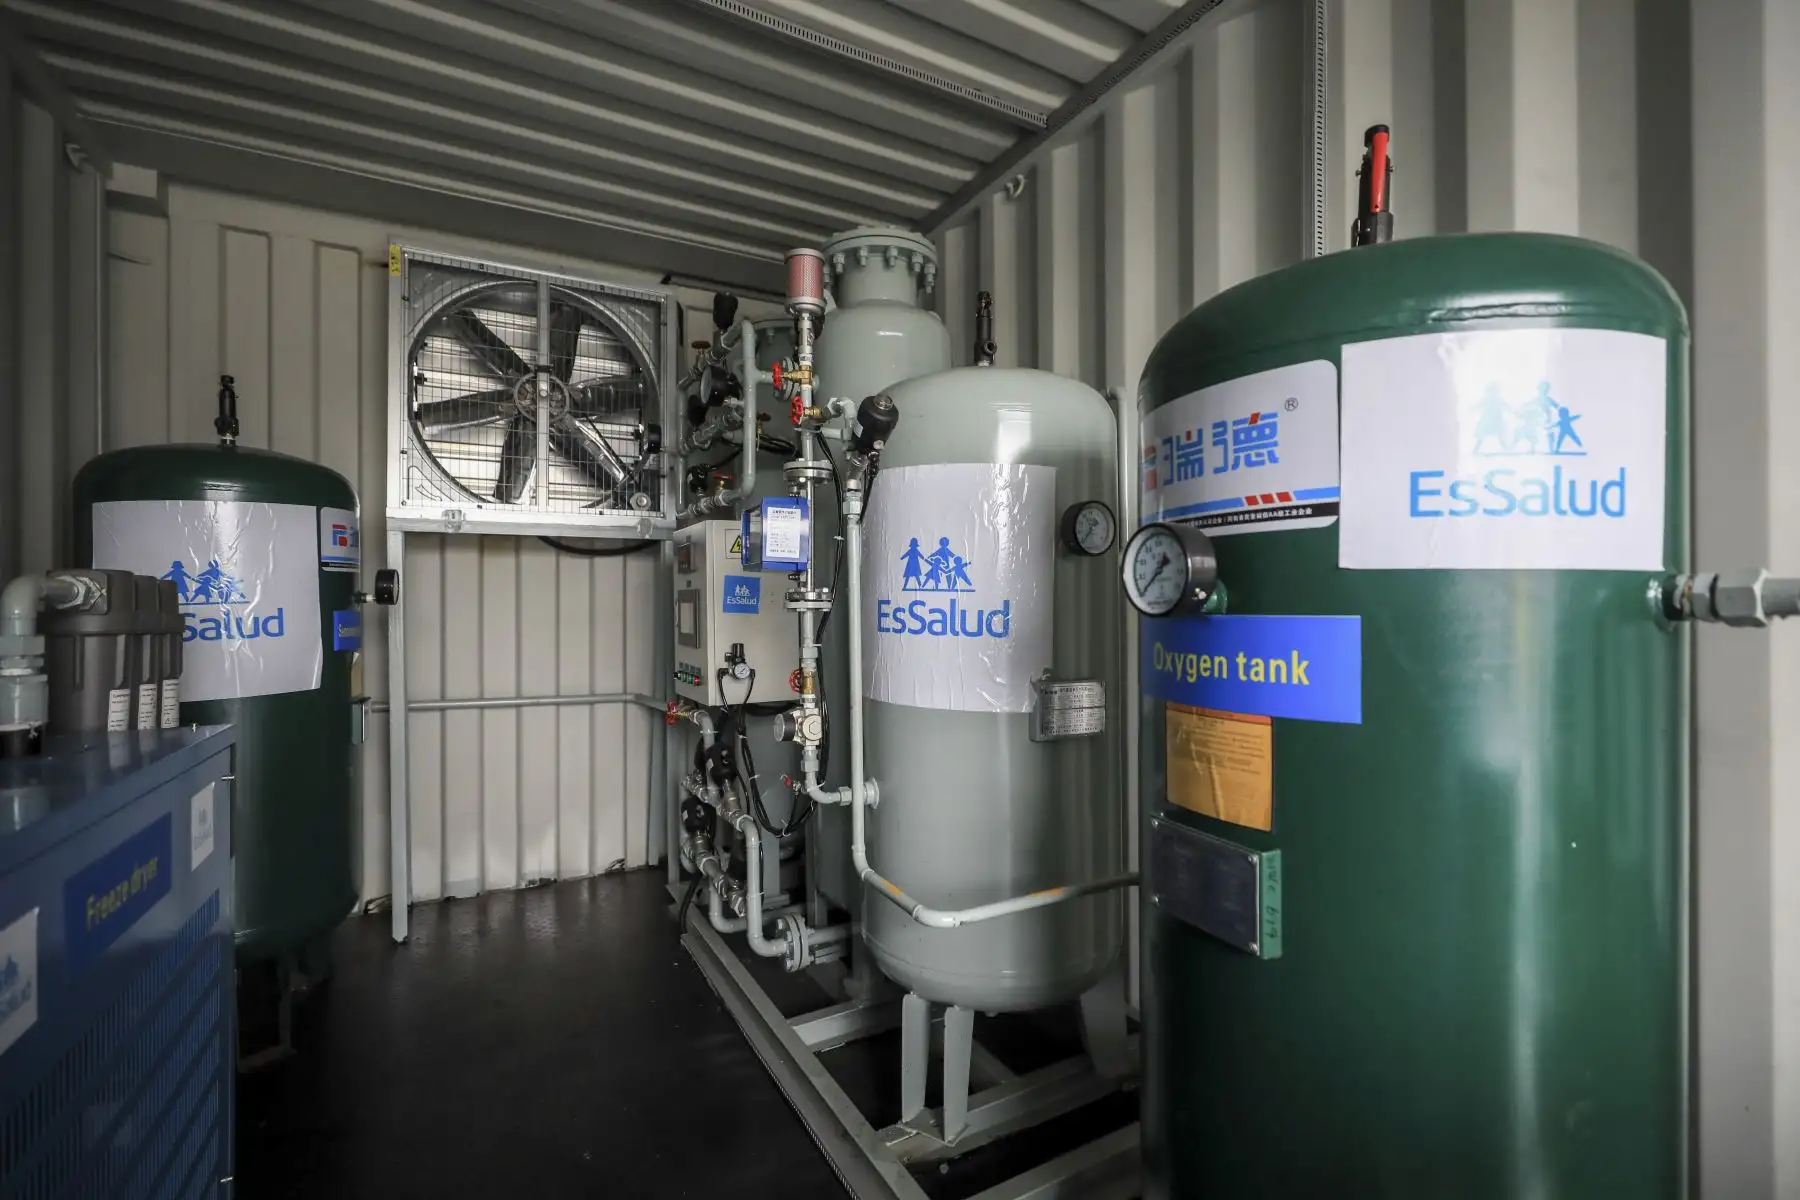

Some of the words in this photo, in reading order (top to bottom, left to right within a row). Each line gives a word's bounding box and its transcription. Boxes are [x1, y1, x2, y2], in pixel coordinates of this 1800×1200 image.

[1410, 464, 1626, 518] EsSalud
[727, 596, 757, 605] EsSalud
[877, 598, 1010, 638] EsSalud
[182, 607, 285, 643] Salud
[1153, 641, 1229, 684] Oxygen
[1236, 649, 1310, 686] tank
[86, 879, 129, 931] Freeze
[130, 856, 159, 896] dryer
